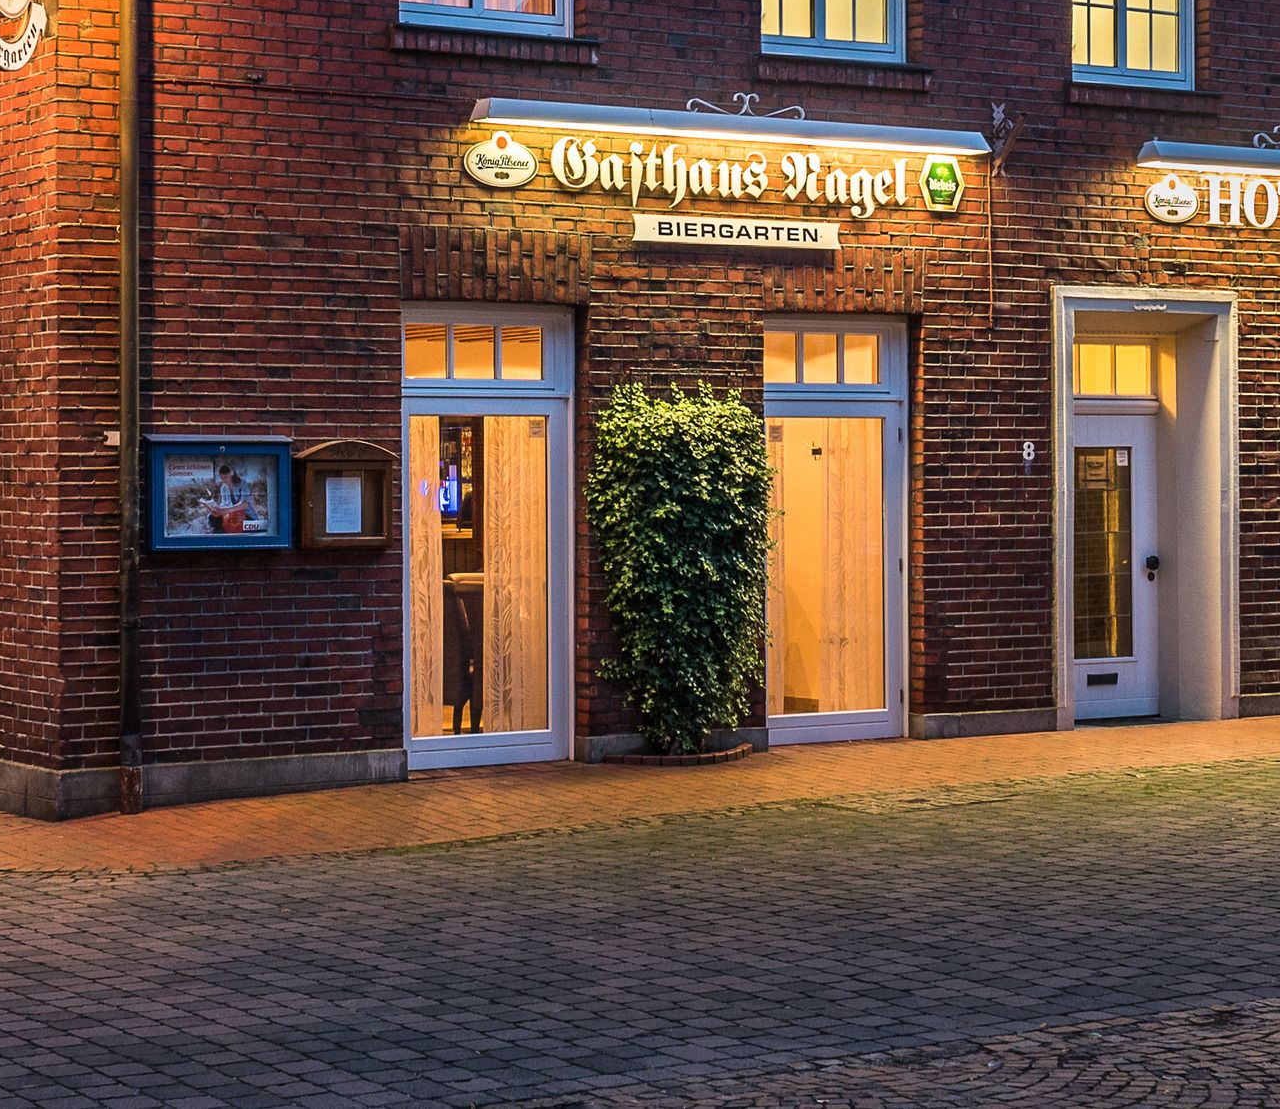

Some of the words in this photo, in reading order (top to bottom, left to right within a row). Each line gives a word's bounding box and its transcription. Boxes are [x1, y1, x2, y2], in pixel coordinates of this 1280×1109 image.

[780, 151, 910, 218] Nagel
[657, 221, 819, 243] BIERGARTEN
[1023, 441, 1035, 461] 8
